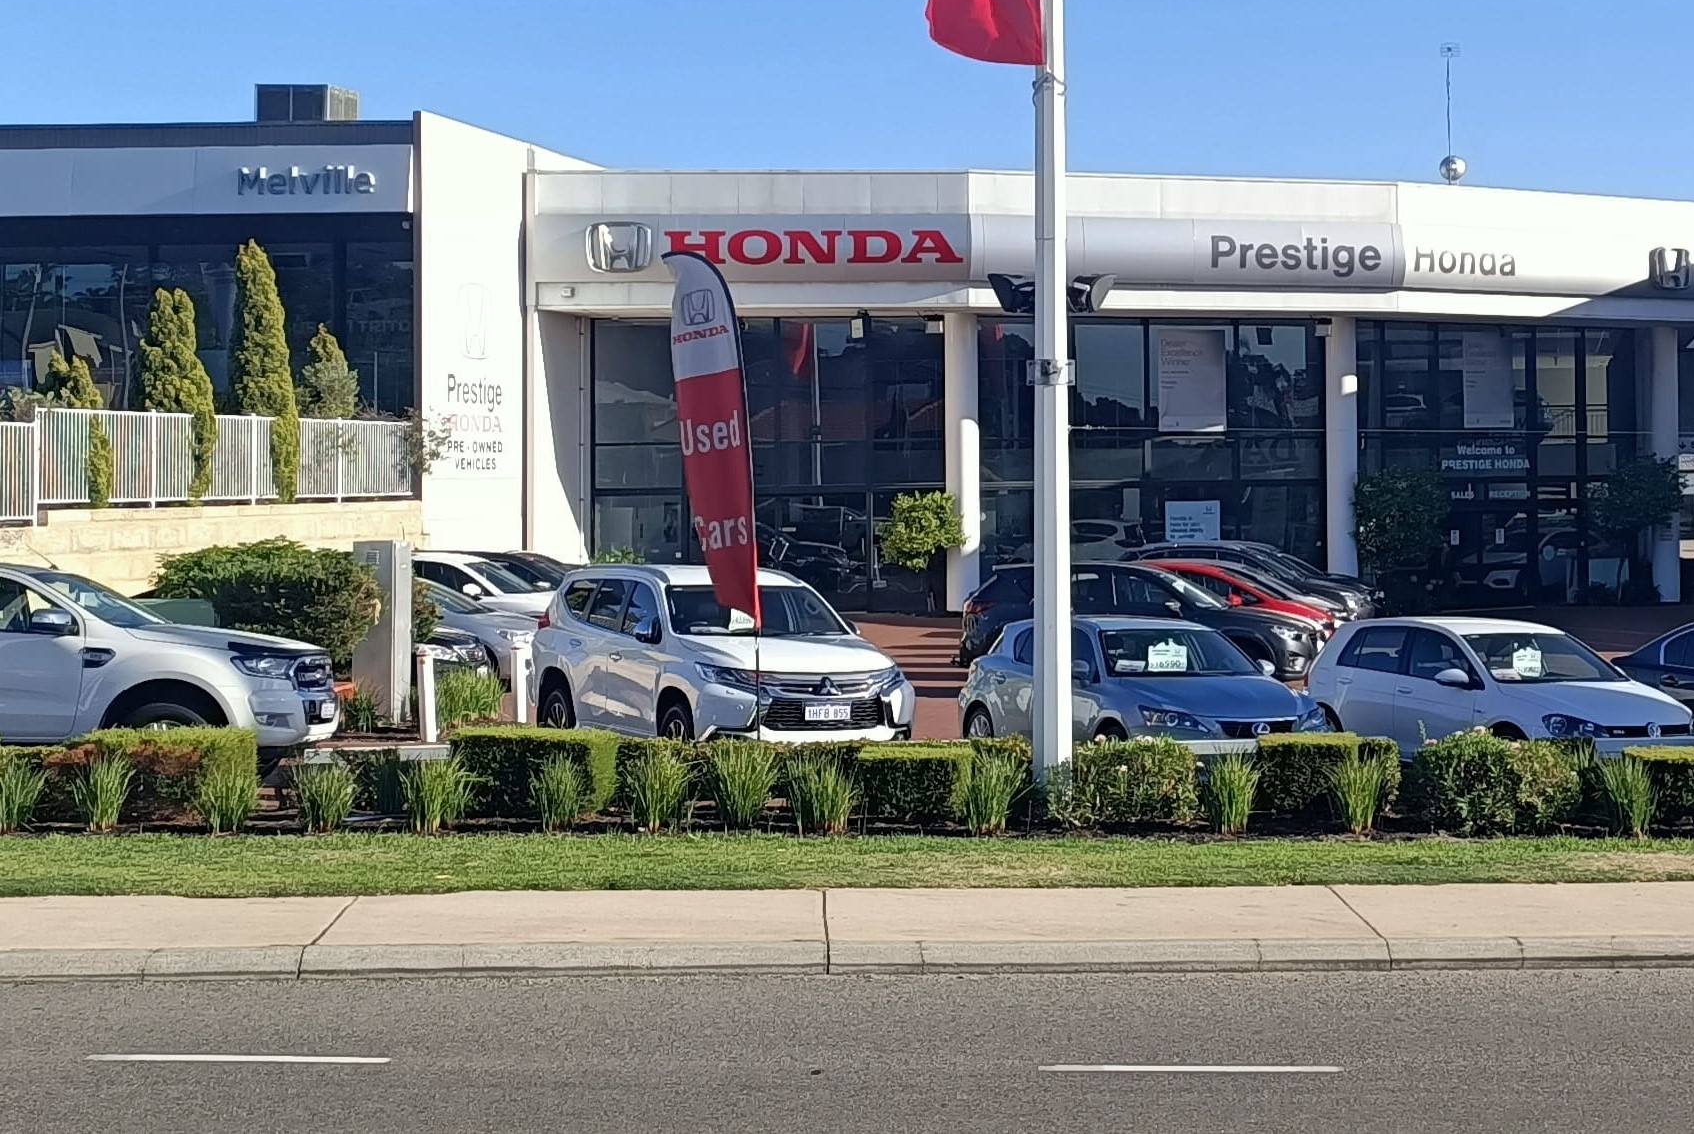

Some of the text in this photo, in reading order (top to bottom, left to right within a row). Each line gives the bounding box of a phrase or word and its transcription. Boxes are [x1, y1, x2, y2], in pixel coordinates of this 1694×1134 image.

[237, 165, 376, 196] Melville
[663, 230, 964, 265] HONDA
[1211, 234, 1382, 277] Prestige
[673, 325, 729, 345] HONDA
[448, 373, 502, 412] Prestige
[680, 410, 741, 456] Used
[455, 457, 498, 470] VEHICLES
[1441, 458, 1531, 470] PRESTIGE HONDA
[1456, 443, 1516, 455] Welcome to
